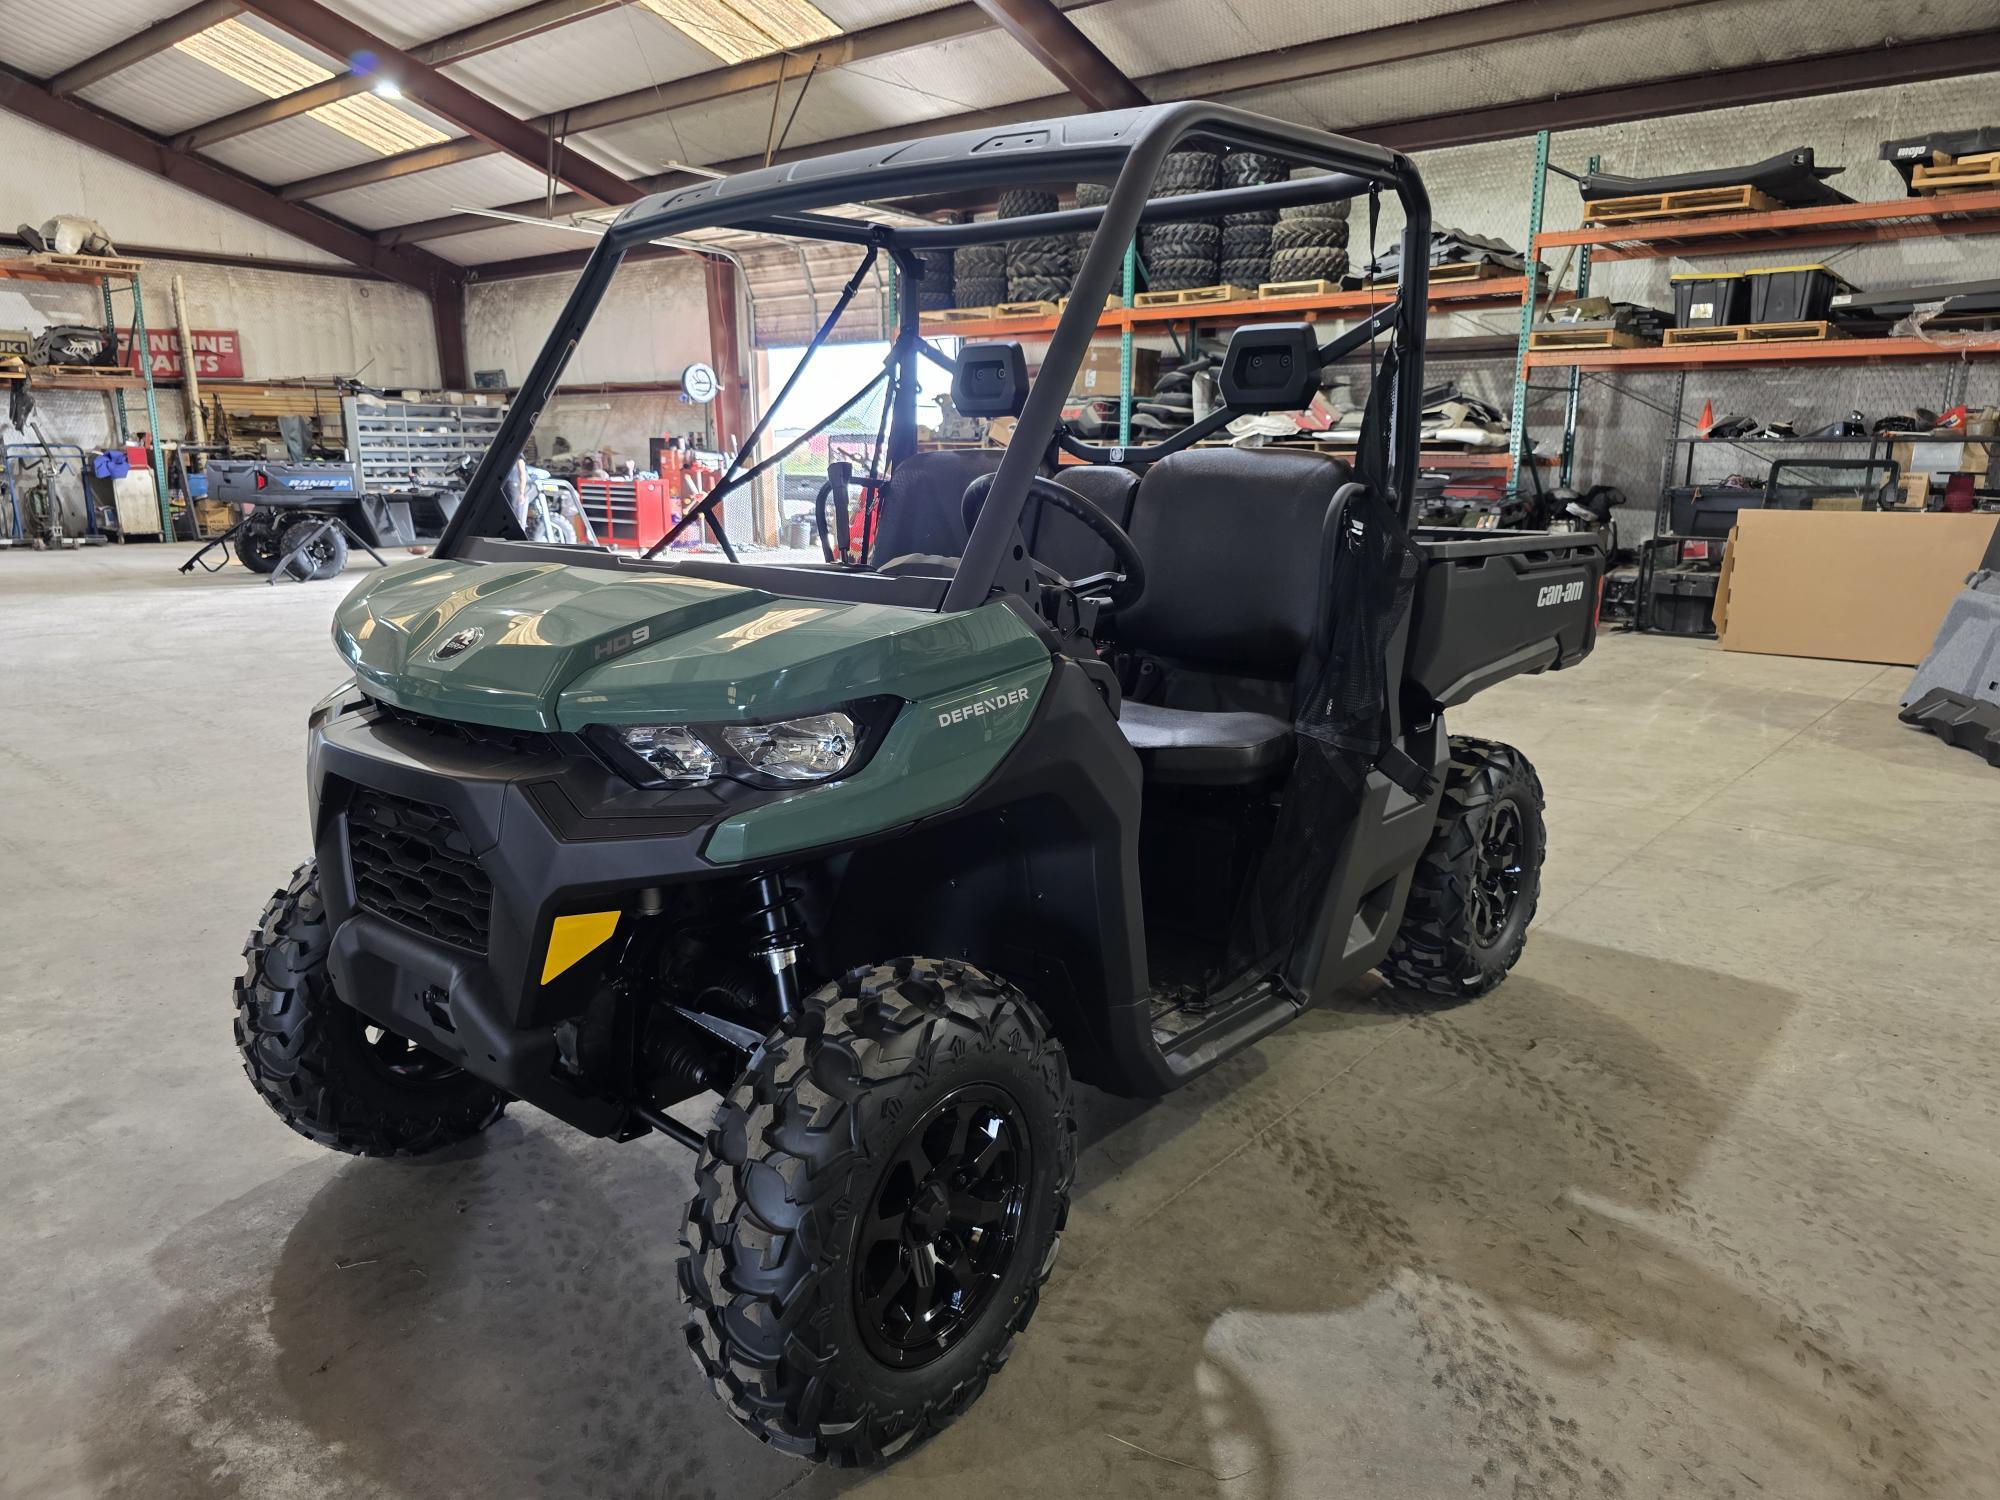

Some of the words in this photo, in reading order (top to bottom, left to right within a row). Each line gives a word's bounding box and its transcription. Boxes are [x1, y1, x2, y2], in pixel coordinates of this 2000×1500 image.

[288, 479, 350, 487] RANGER
[1537, 581, 1584, 607] can-am
[594, 625, 650, 660] HD9
[938, 687, 1029, 728] DEFENDER
